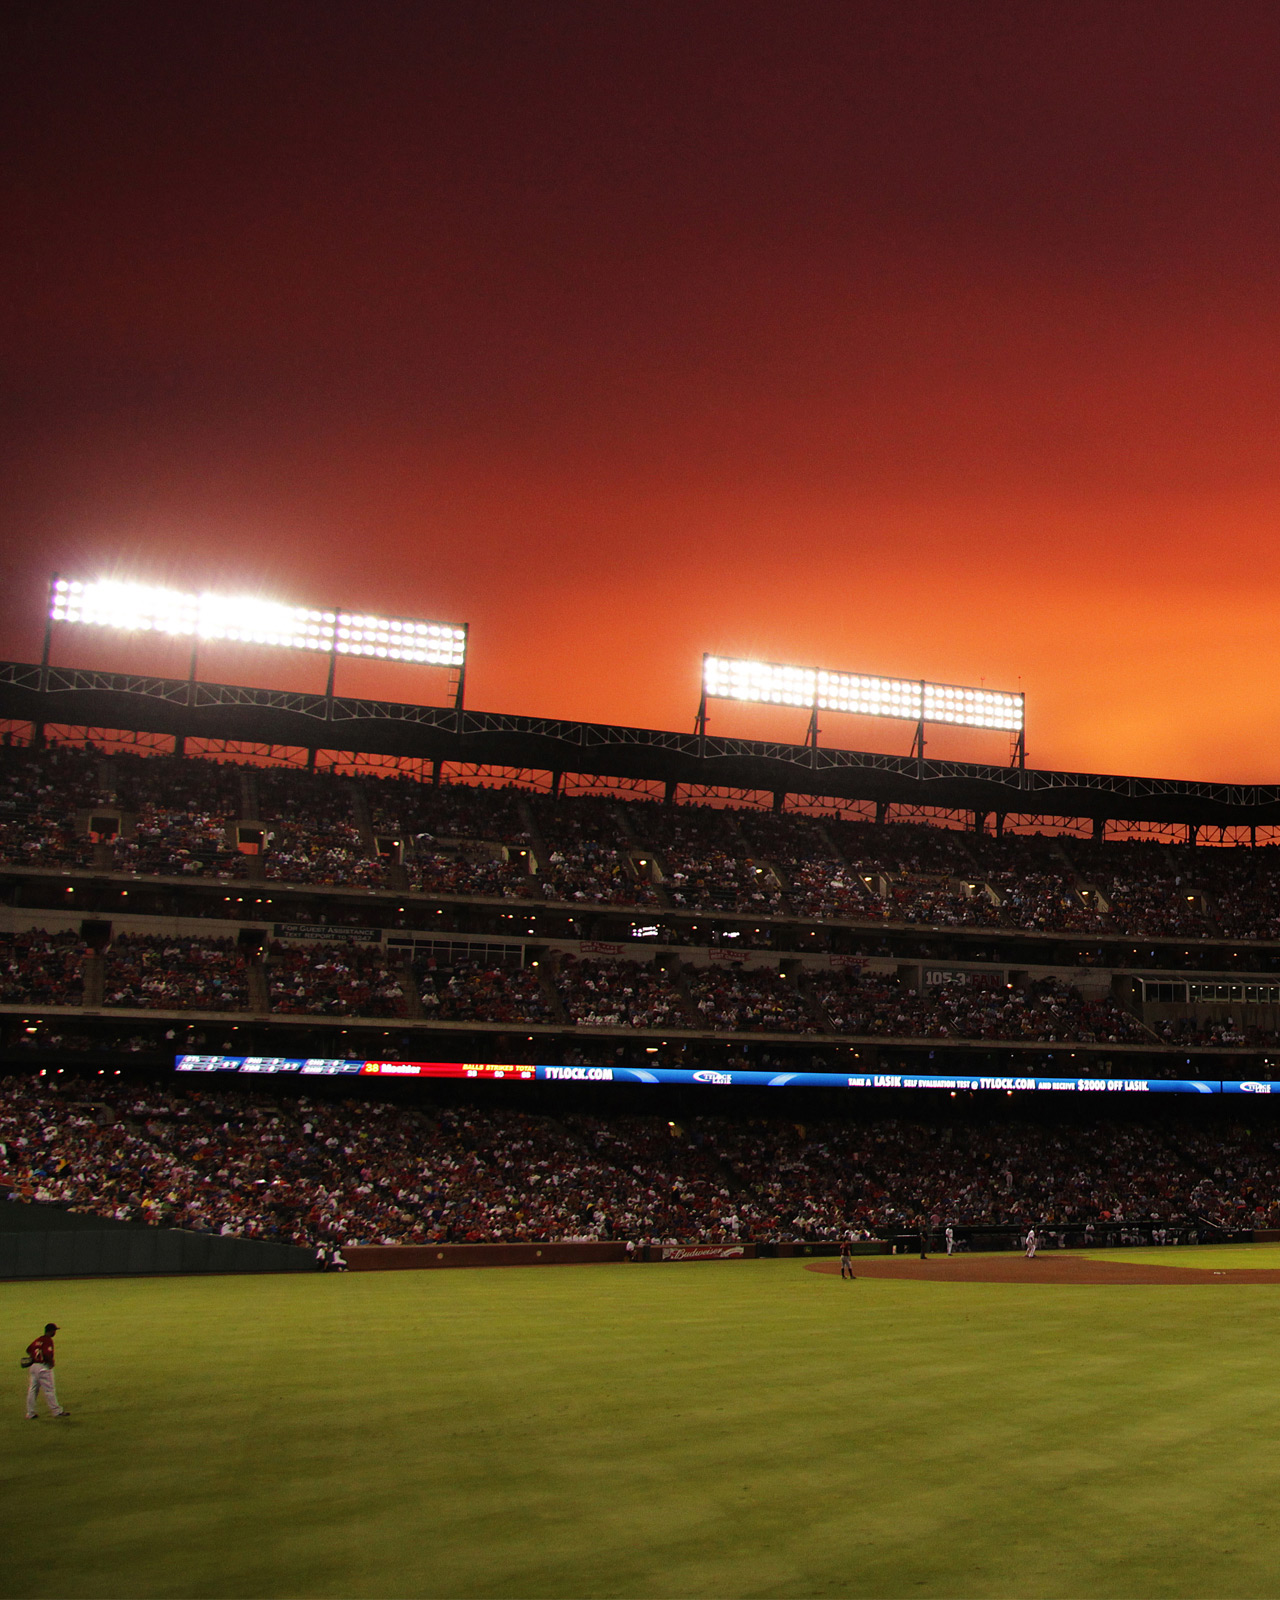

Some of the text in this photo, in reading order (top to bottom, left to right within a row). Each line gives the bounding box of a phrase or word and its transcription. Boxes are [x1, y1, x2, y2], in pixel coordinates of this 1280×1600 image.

[971, 974, 1001, 986] FAN
[365, 1063, 379, 1072] 38
[545, 1067, 613, 1080] TYLOCK.COM
[865, 1078, 872, 1086] A
[874, 1075, 901, 1087] LASIK
[904, 1079, 918, 1087] SELF
[956, 1080, 971, 1088] TEST
[980, 1078, 1035, 1089] TYLOCK.COM
[1077, 1079, 1106, 1091] $2000
[1107, 1080, 1123, 1091] OFF
[674, 1247, 723, 1260] Budweiser
